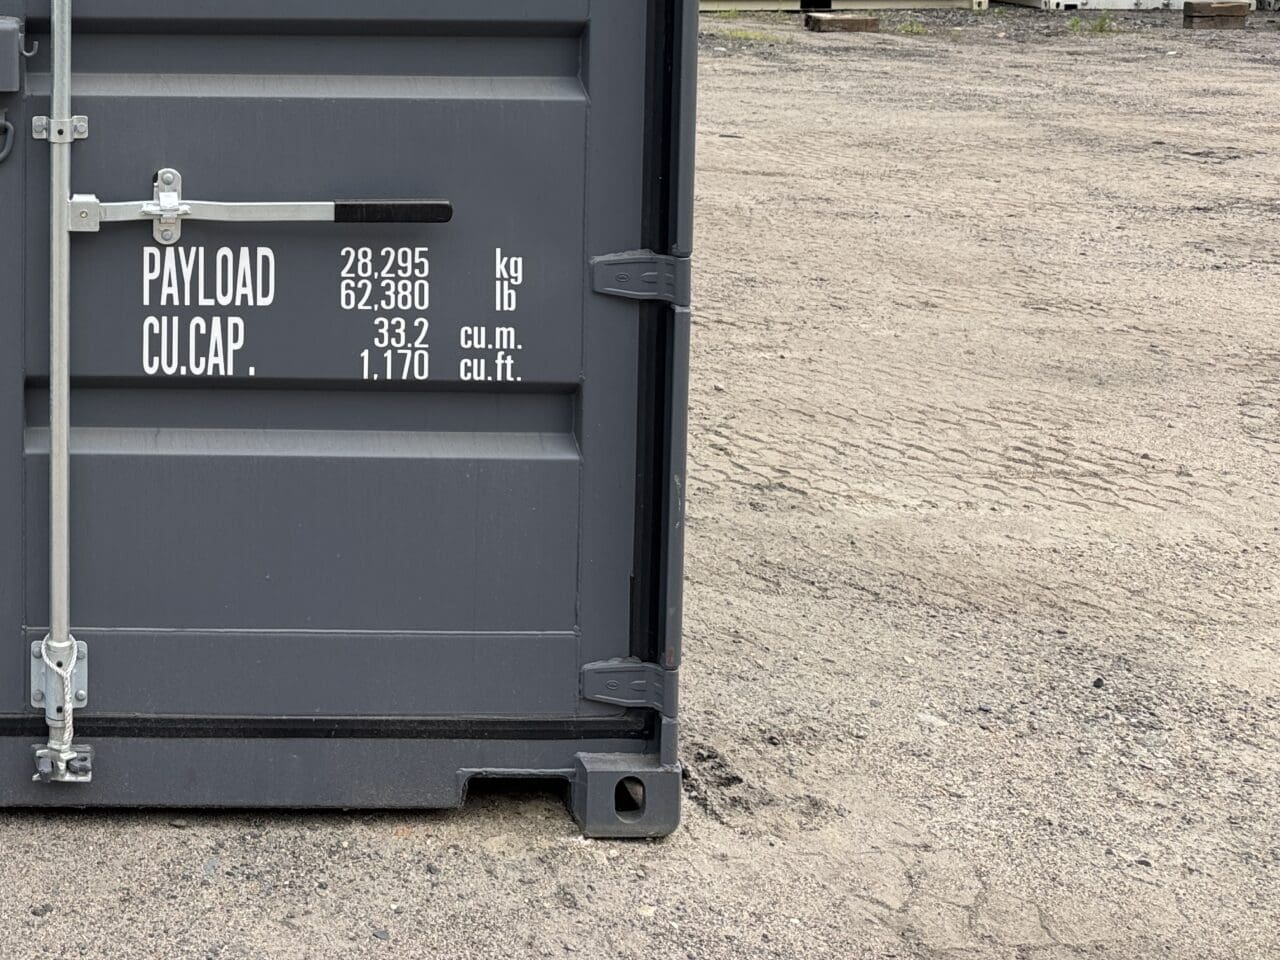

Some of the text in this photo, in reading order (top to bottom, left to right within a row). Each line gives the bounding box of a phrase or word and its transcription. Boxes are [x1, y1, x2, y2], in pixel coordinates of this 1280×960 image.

[142, 246, 523, 306] PAYLOAD 28,295 kg
[340, 280, 516, 311] 62,380 lb
[373, 318, 429, 348] 33.2
[460, 324, 522, 349] cu.m.
[360, 350, 521, 381] 1,170 cu.ft.
